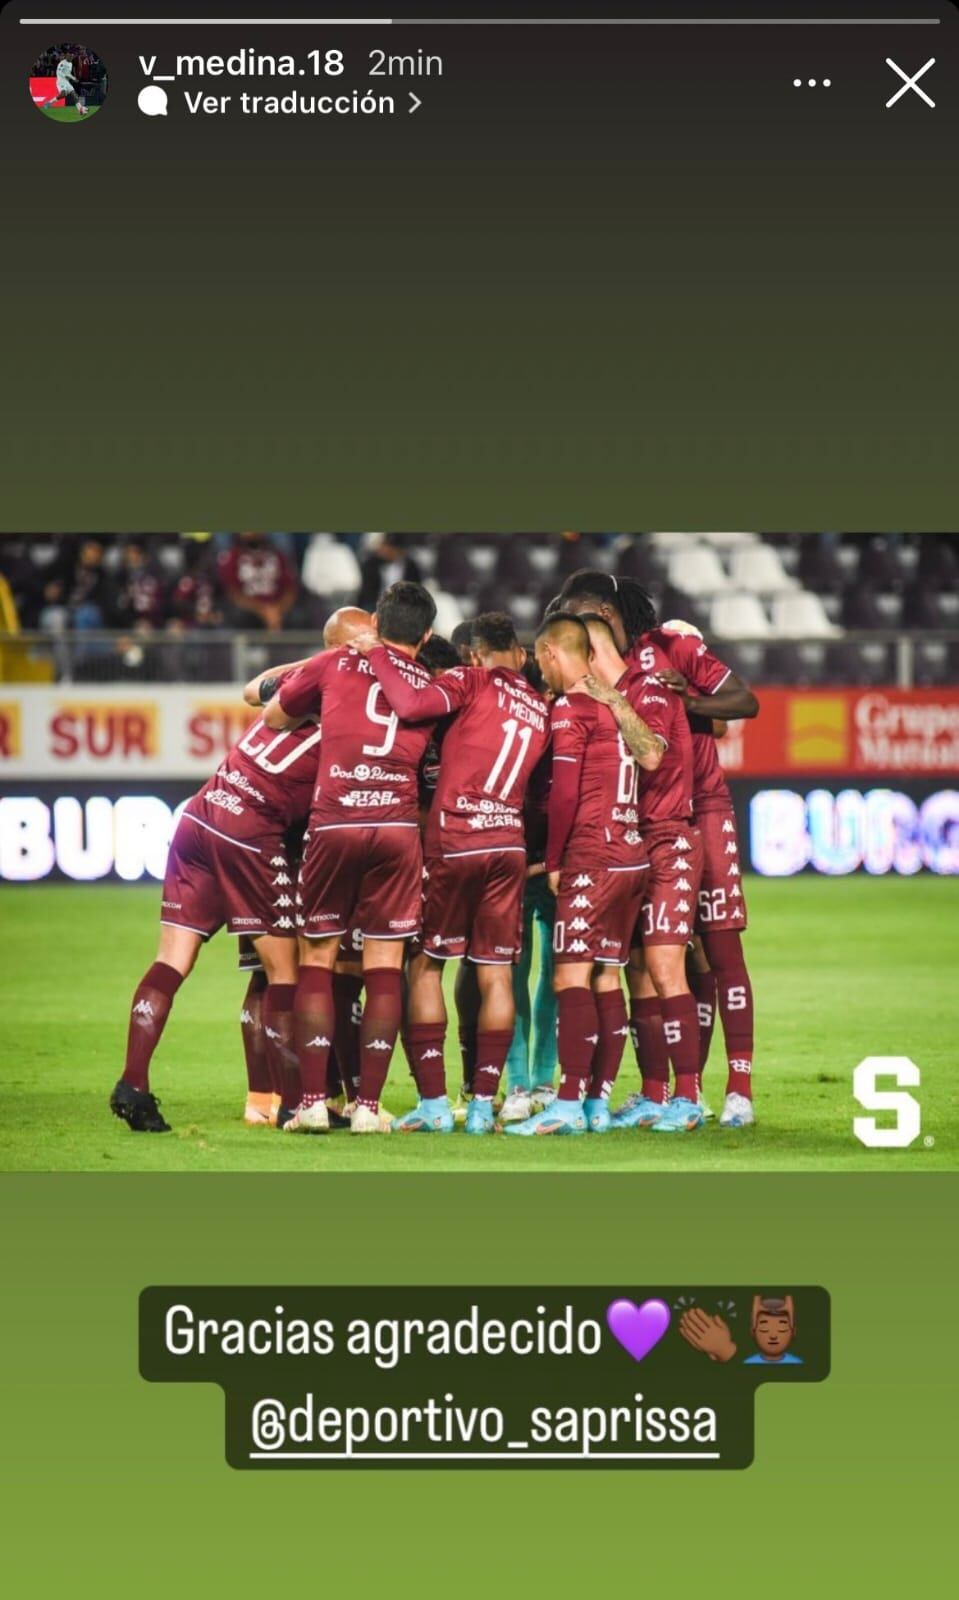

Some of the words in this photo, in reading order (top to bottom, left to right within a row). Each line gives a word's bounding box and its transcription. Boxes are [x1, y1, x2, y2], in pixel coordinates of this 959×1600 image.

[639, 646, 656, 670] S
[50, 711, 155, 758] SUR
[362, 682, 400, 757] 9
[483, 718, 533, 801] 11
[0, 796, 188, 880] BUR
[642, 902, 670, 935] 34
[698, 888, 727, 921] 52
[727, 986, 747, 1010] S
[664, 1020, 682, 1044] S
